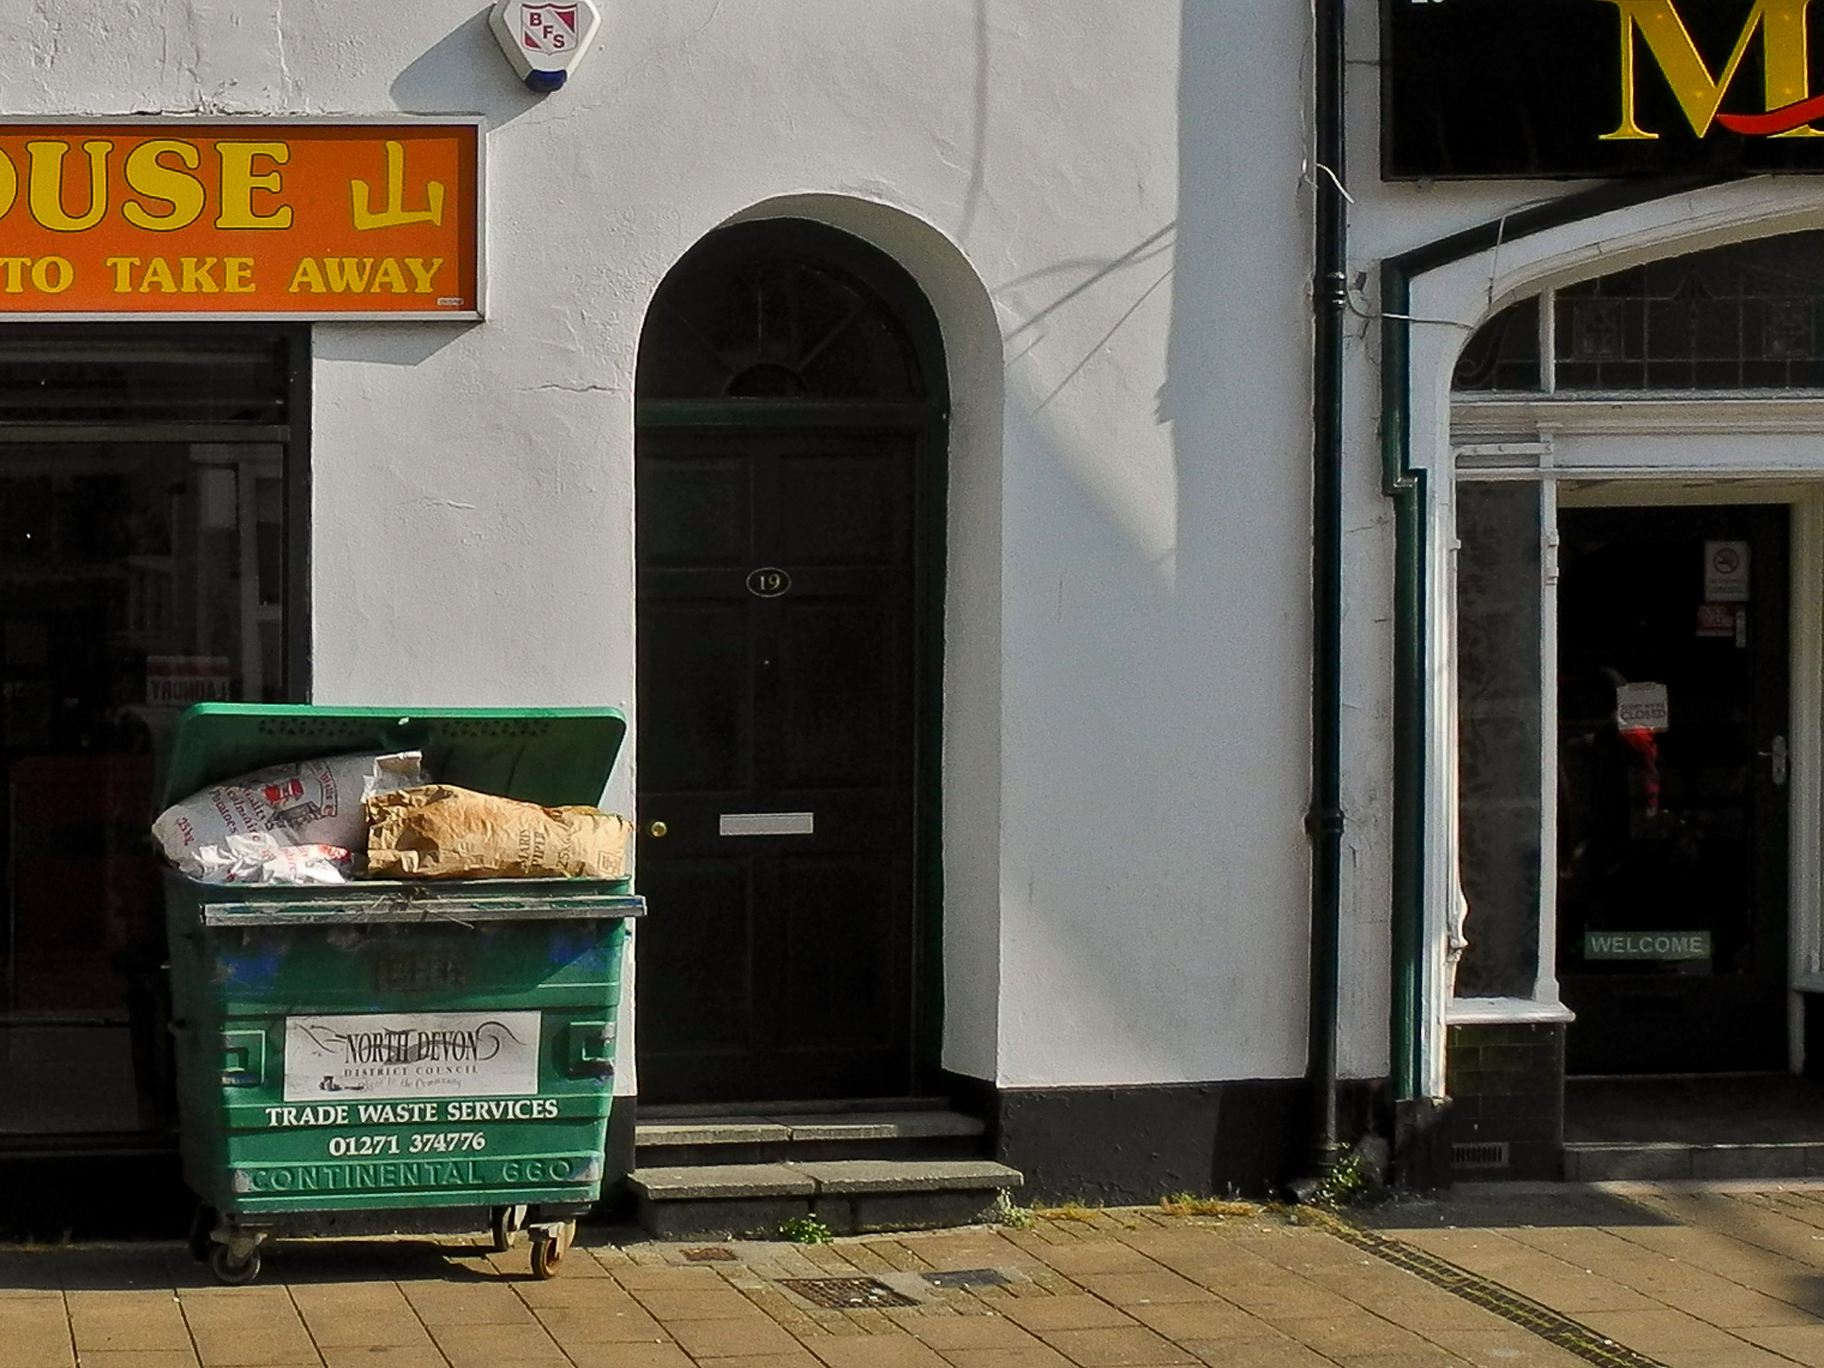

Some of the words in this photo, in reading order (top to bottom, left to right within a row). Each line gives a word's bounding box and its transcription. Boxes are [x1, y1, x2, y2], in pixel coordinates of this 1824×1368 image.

[350, 140, 446, 231] 山
[107, 255, 256, 295] TAKE
[289, 255, 444, 295] AWAY
[760, 574, 781, 590] 19
[1591, 936, 1703, 953] WELCOME
[345, 1031, 409, 1064] NORTH
[417, 1030, 478, 1062] DEVON
[344, 1066, 407, 1077] DISTRICT
[416, 1065, 477, 1075] COUNCIL
[266, 1106, 349, 1126] TRADE
[358, 1103, 437, 1124] WASTE
[447, 1099, 559, 1121] SERVICES
[329, 1135, 400, 1157] 01271
[409, 1132, 486, 1154] 374776
[251, 1161, 485, 1192] CONTINENTAL
[502, 1160, 574, 1183] 660
